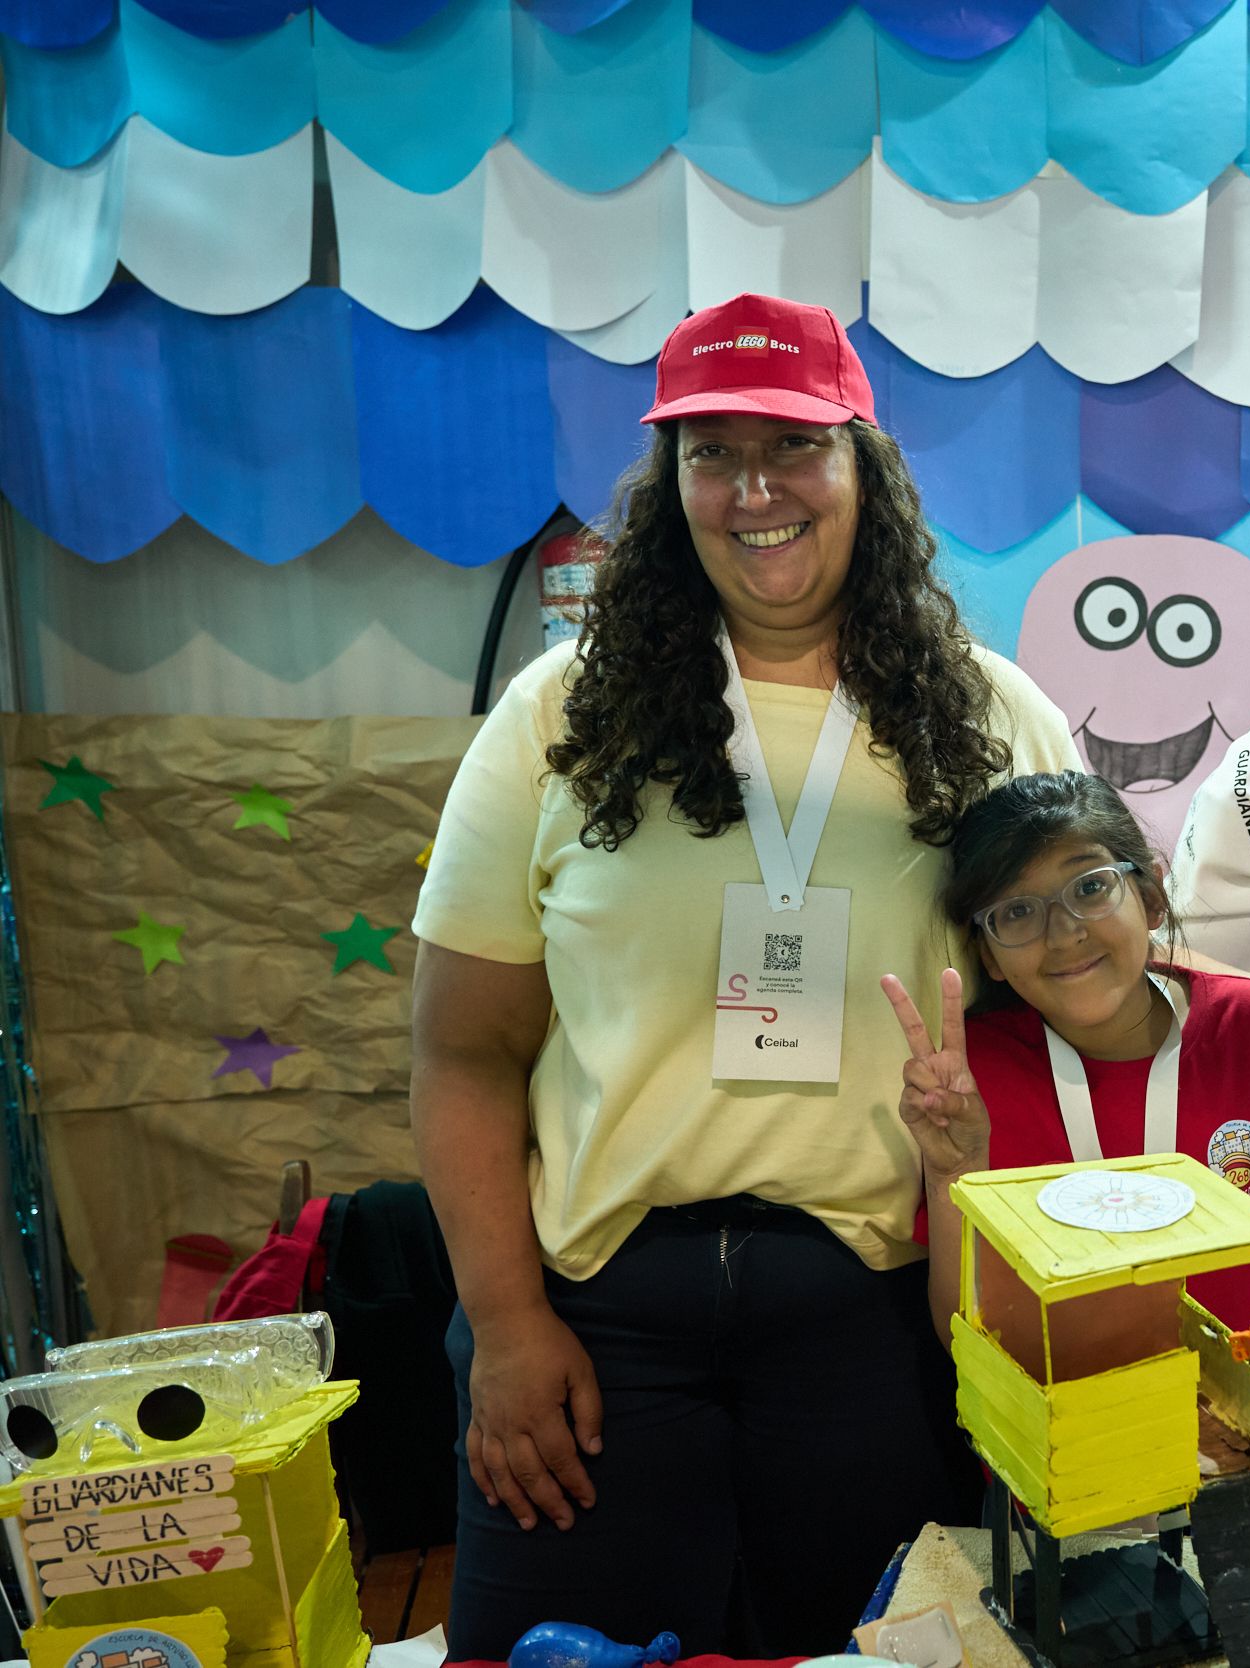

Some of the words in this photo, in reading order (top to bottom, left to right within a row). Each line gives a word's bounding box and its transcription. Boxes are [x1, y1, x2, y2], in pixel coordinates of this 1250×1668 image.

[692, 340, 733, 356] Electro
[736, 335, 768, 349] LEGO
[769, 339, 800, 354] Bots
[764, 1038, 799, 1048] Ceibal
[1229, 1170, 1249, 1185] 268
[33, 1464, 215, 1516] GUARDIANES
[63, 1522, 101, 1552] DE
[142, 1512, 188, 1542] LA
[87, 1553, 182, 1587] VIDA
[108, 1634, 144, 1643] ESCUELA
